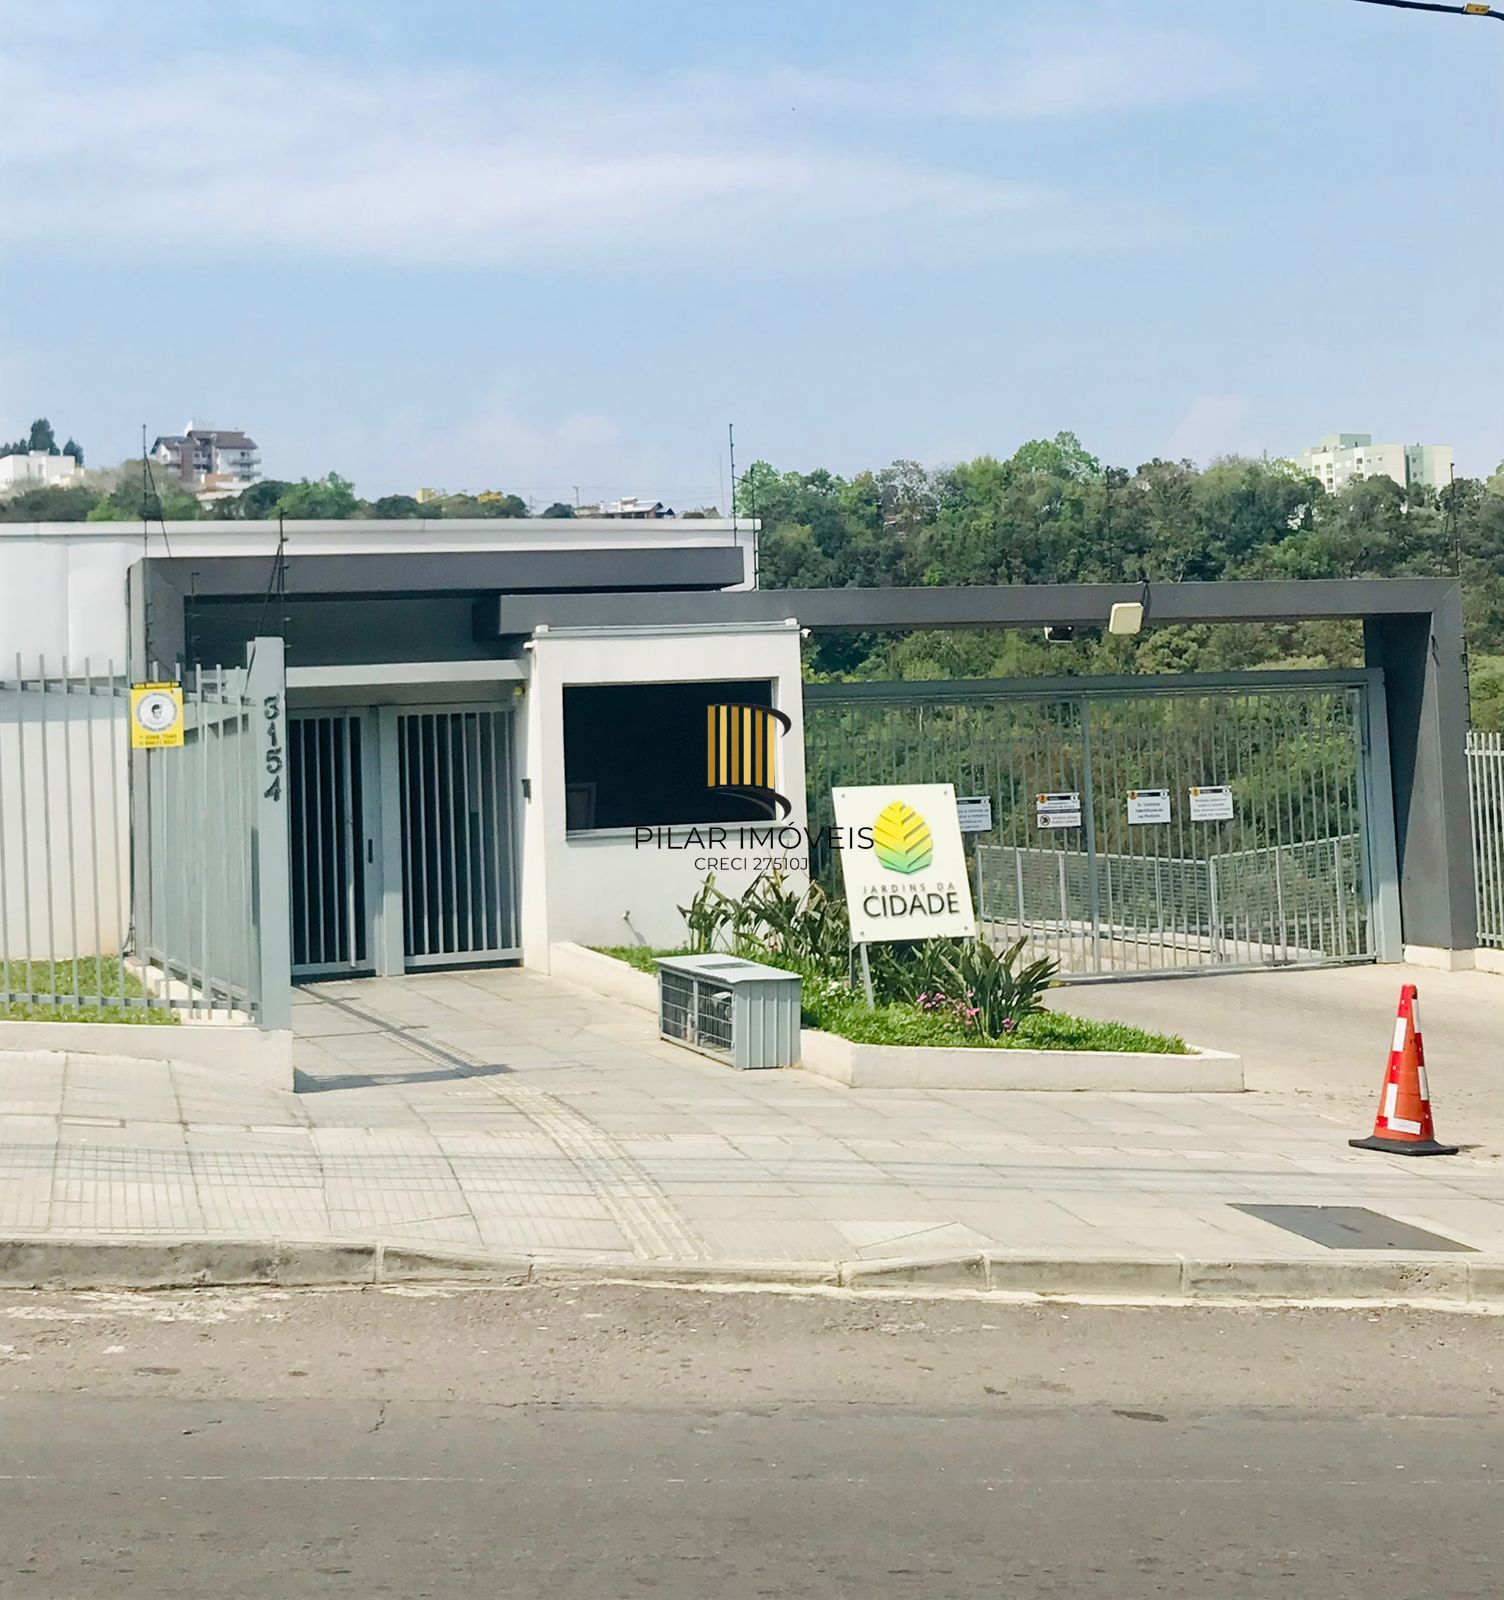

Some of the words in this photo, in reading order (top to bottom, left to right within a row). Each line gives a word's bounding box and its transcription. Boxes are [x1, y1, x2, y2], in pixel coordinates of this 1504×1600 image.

[264, 694, 283, 802] 3154
[863, 882, 926, 895] JARDINS
[936, 881, 956, 892] DA
[862, 891, 960, 918] CIDADE
